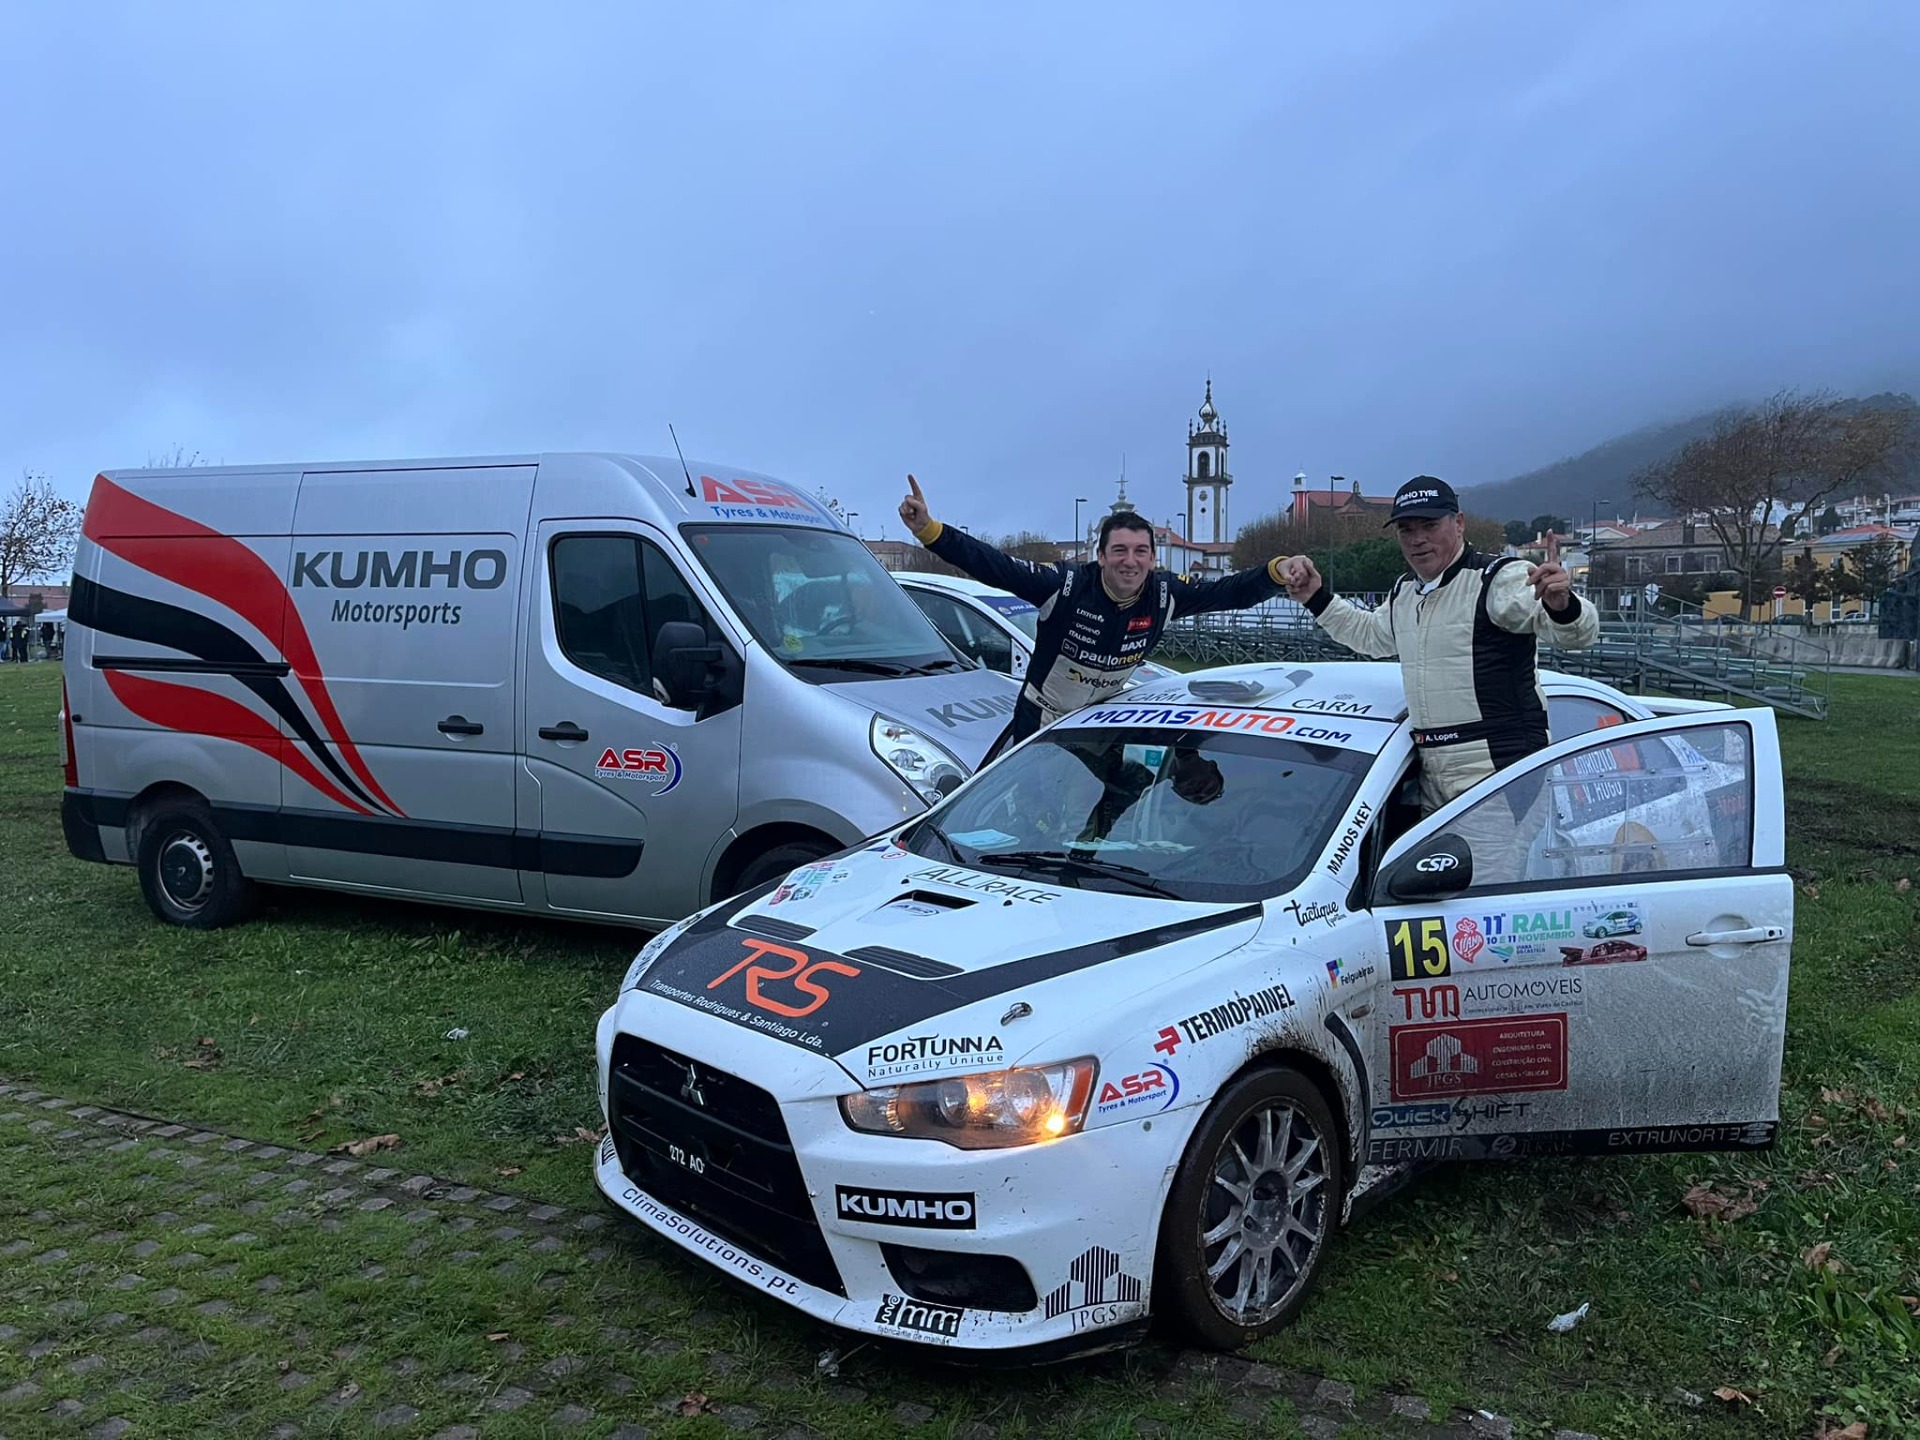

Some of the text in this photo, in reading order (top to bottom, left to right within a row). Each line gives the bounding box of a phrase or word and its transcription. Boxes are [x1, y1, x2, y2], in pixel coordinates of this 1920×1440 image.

[700, 475, 813, 513] ASR
[1418, 489, 1439, 497] TYRE
[711, 506, 754, 518] Tyres
[756, 508, 767, 518] &
[292, 549, 507, 590] KUMHO
[331, 599, 462, 631] Motorsports
[1068, 629, 1097, 646] ITALBOX
[1121, 638, 1147, 652] BAXI
[1080, 673, 1125, 689] weber
[1291, 698, 1372, 715] CARM
[1433, 732, 1459, 742] Lopes
[596, 747, 668, 773] ASR
[595, 769, 615, 779] Tyres
[624, 770, 666, 783] Motorsport
[1327, 801, 1372, 875] MANOS KEY
[1416, 857, 1455, 872] CSP
[1512, 910, 1571, 934] RALI
[1394, 919, 1448, 977] 15
[1486, 930, 1576, 945] 10 E 11 NOVEMBRO
[1340, 964, 1374, 986] Felgueiras
[650, 979, 823, 1049] Transportes Rodrigues & Santiago Lda.
[1178, 983, 1296, 1045] TERMOPAINEL
[868, 1033, 1004, 1066] FORTUNNA
[868, 1053, 1004, 1079] Naturally Unique
[1098, 1069, 1167, 1105] ASR
[1098, 1104, 1118, 1114] Tyres
[1127, 1089, 1167, 1105] Motorsport
[669, 1144, 685, 1165] 272
[840, 1193, 972, 1221] KUMHO
[622, 1187, 800, 1296] ClimaSolutions.pt
[1072, 1304, 1117, 1335] JPGS
